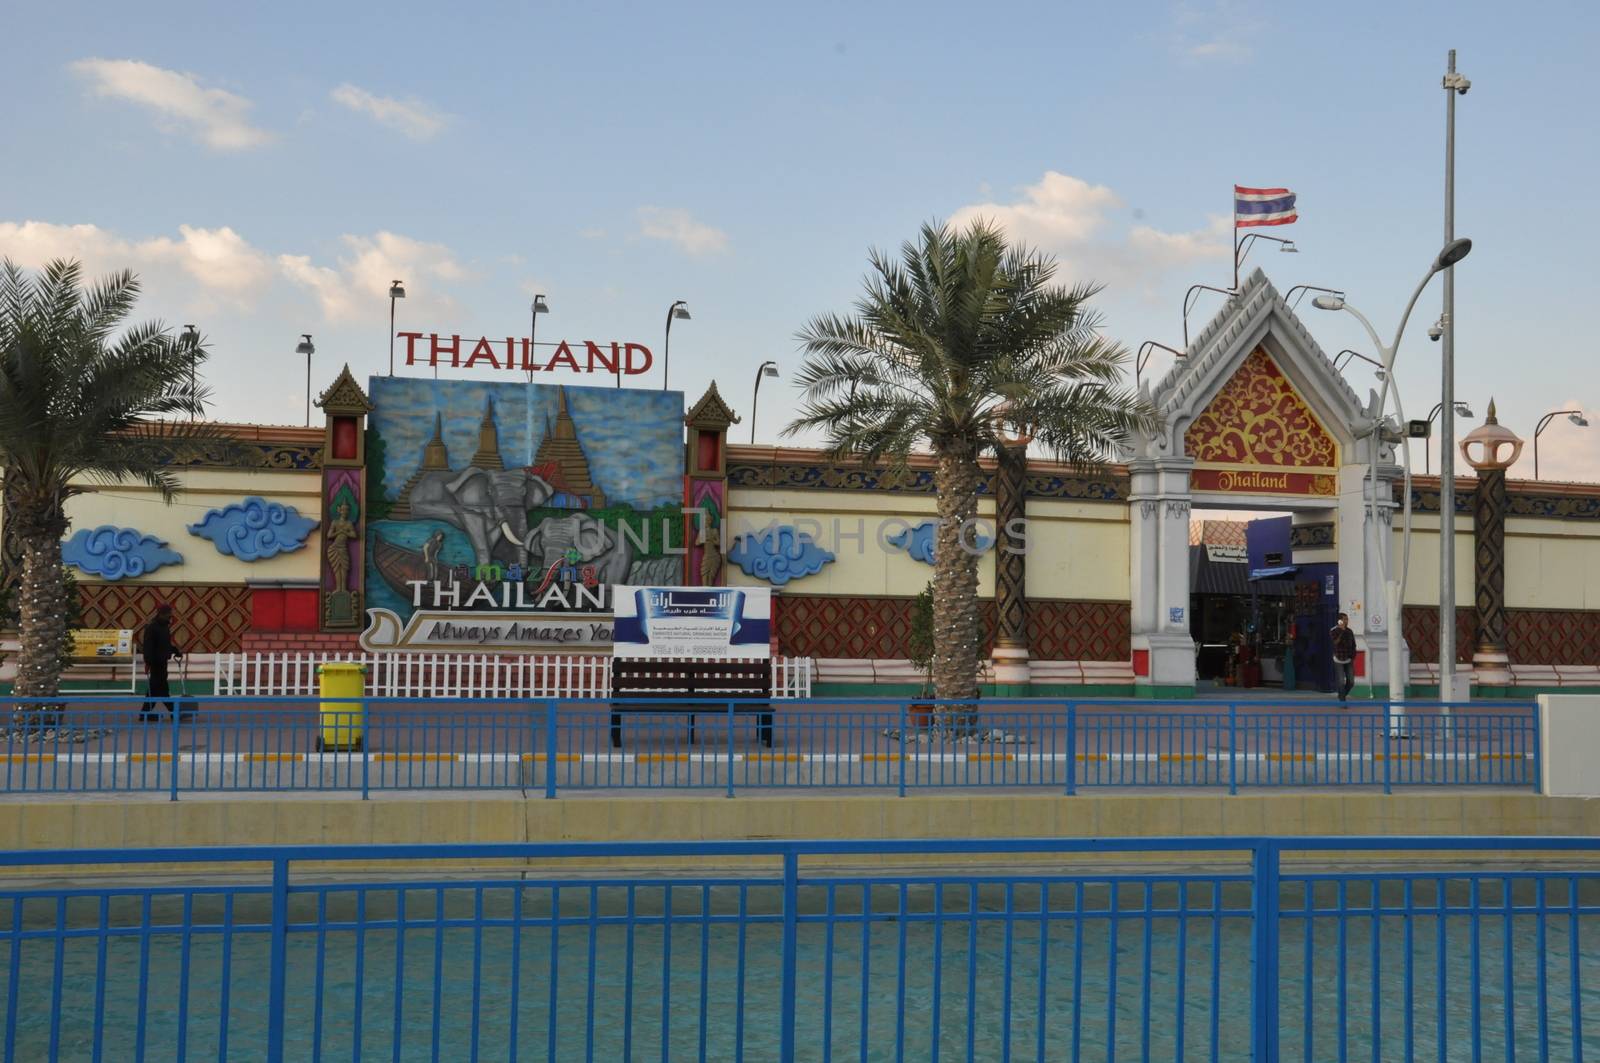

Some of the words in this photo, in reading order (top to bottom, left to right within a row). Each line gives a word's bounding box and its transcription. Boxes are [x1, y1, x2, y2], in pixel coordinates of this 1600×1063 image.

[397, 332, 652, 375] THAILAND
[1218, 471, 1289, 491] Thailand
[406, 580, 614, 609] THAILAN
[427, 622, 501, 643] Always
[504, 622, 583, 643] Amazes
